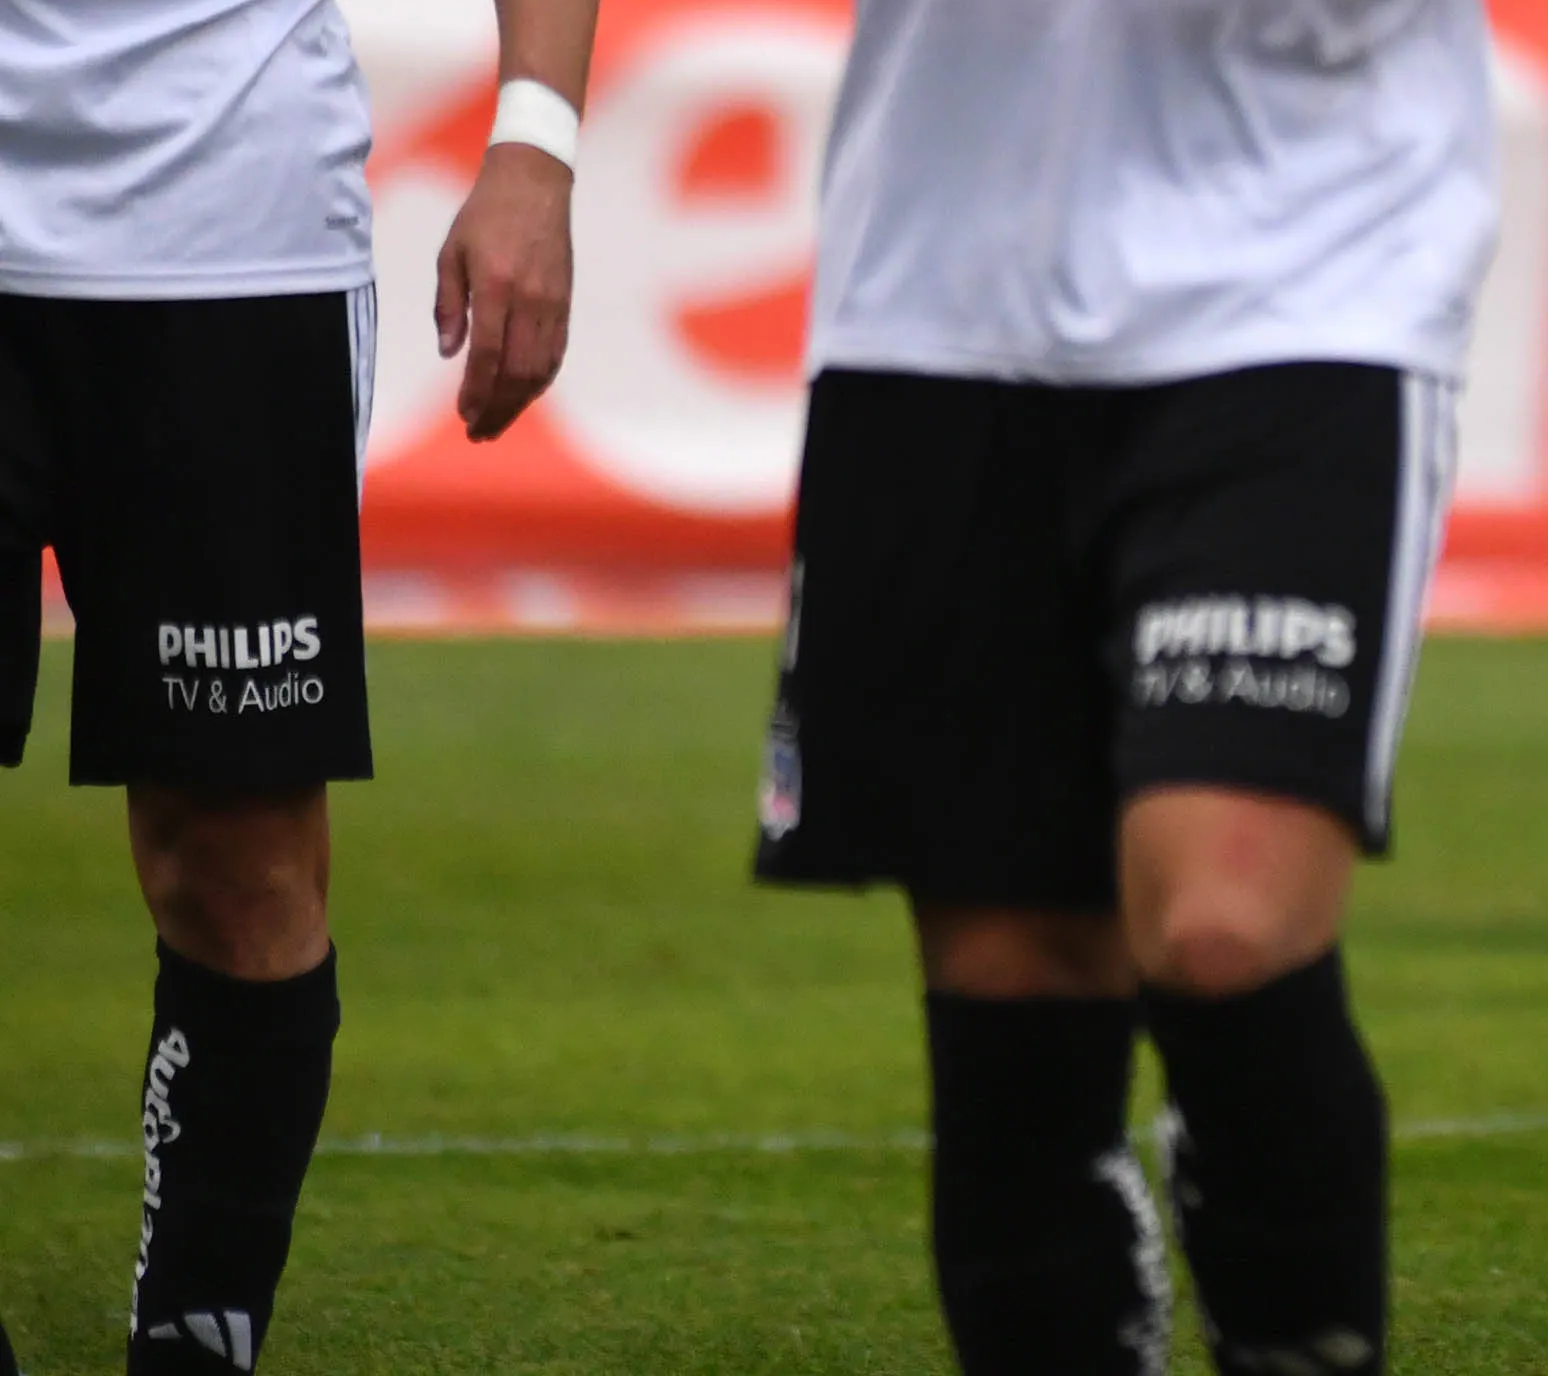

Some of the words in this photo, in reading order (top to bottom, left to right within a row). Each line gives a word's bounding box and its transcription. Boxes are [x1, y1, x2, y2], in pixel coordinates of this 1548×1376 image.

[158, 617, 321, 669] PHILIPS
[162, 677, 199, 711] TV
[209, 680, 227, 713] &
[238, 672, 324, 714] Audio
